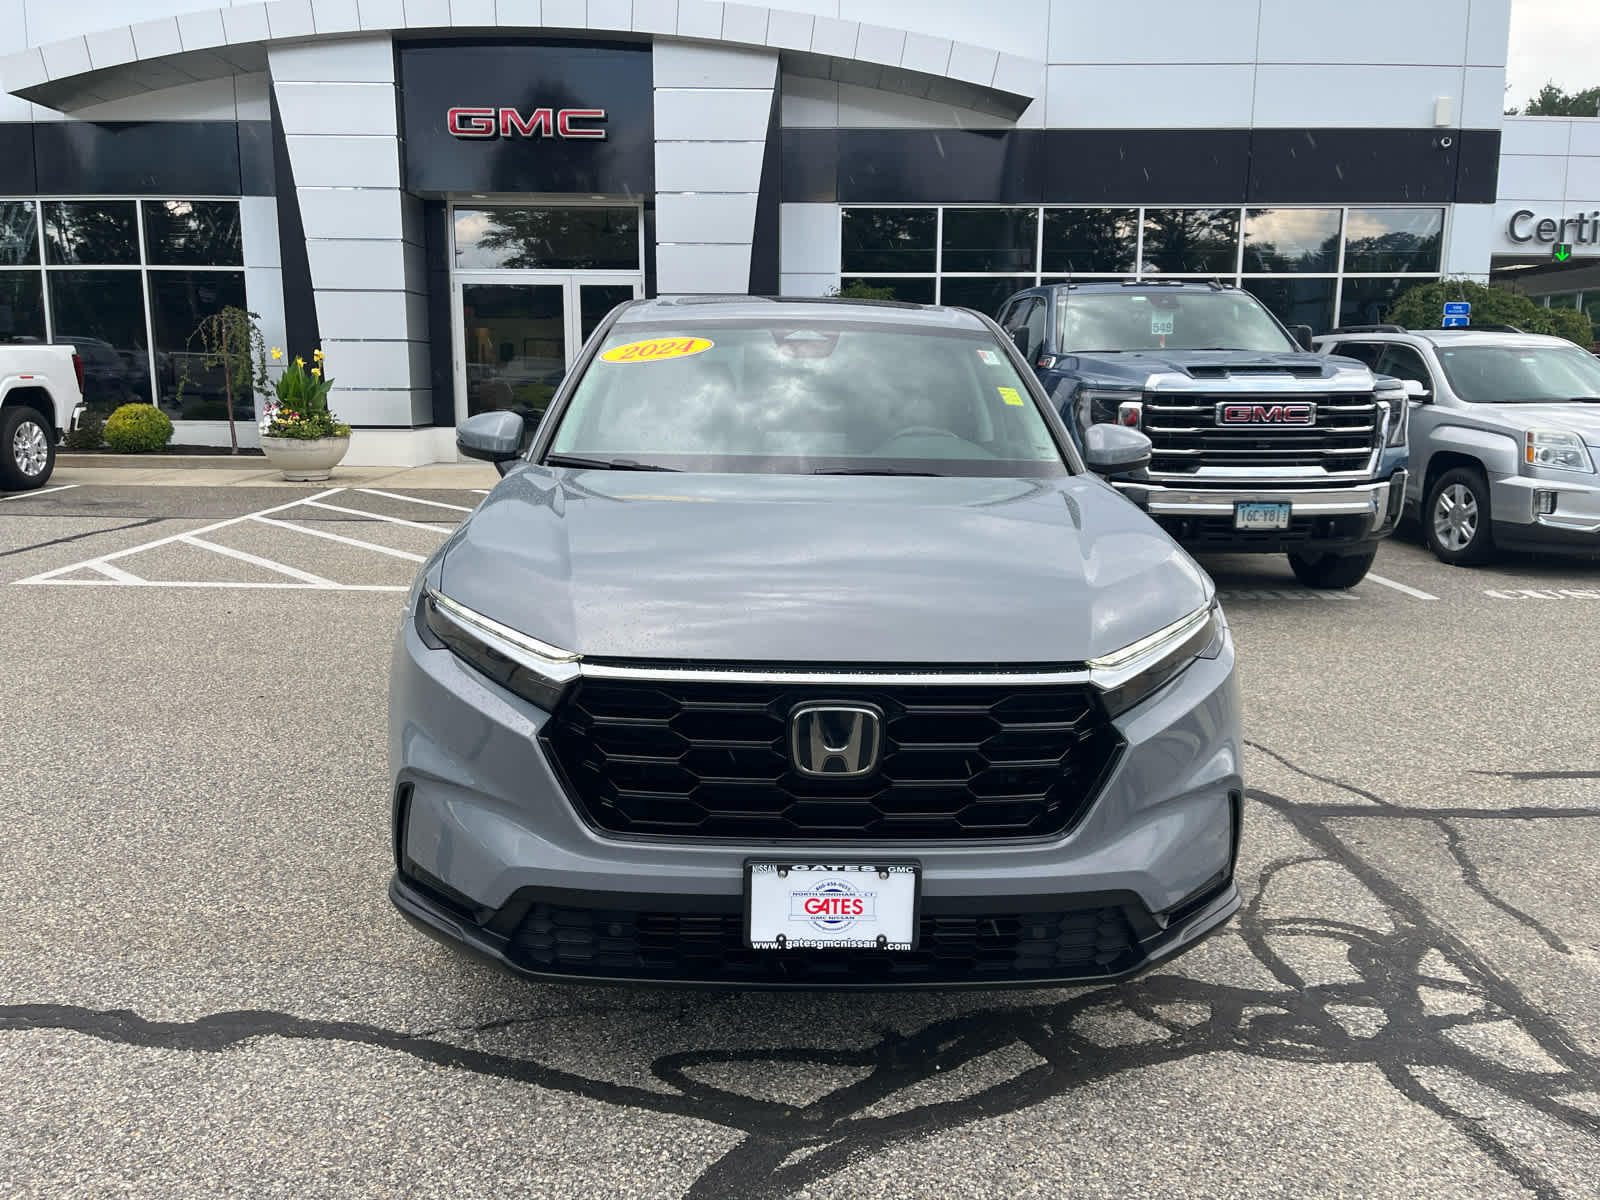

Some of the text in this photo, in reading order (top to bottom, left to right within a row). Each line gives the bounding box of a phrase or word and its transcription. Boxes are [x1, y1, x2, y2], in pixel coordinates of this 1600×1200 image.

[447, 107, 606, 139] GMC
[1508, 209, 1600, 243] Certi
[619, 339, 695, 360] 2024
[1224, 405, 1310, 422] GMC
[752, 865, 778, 873] NISSAN
[804, 897, 864, 915] GATES
